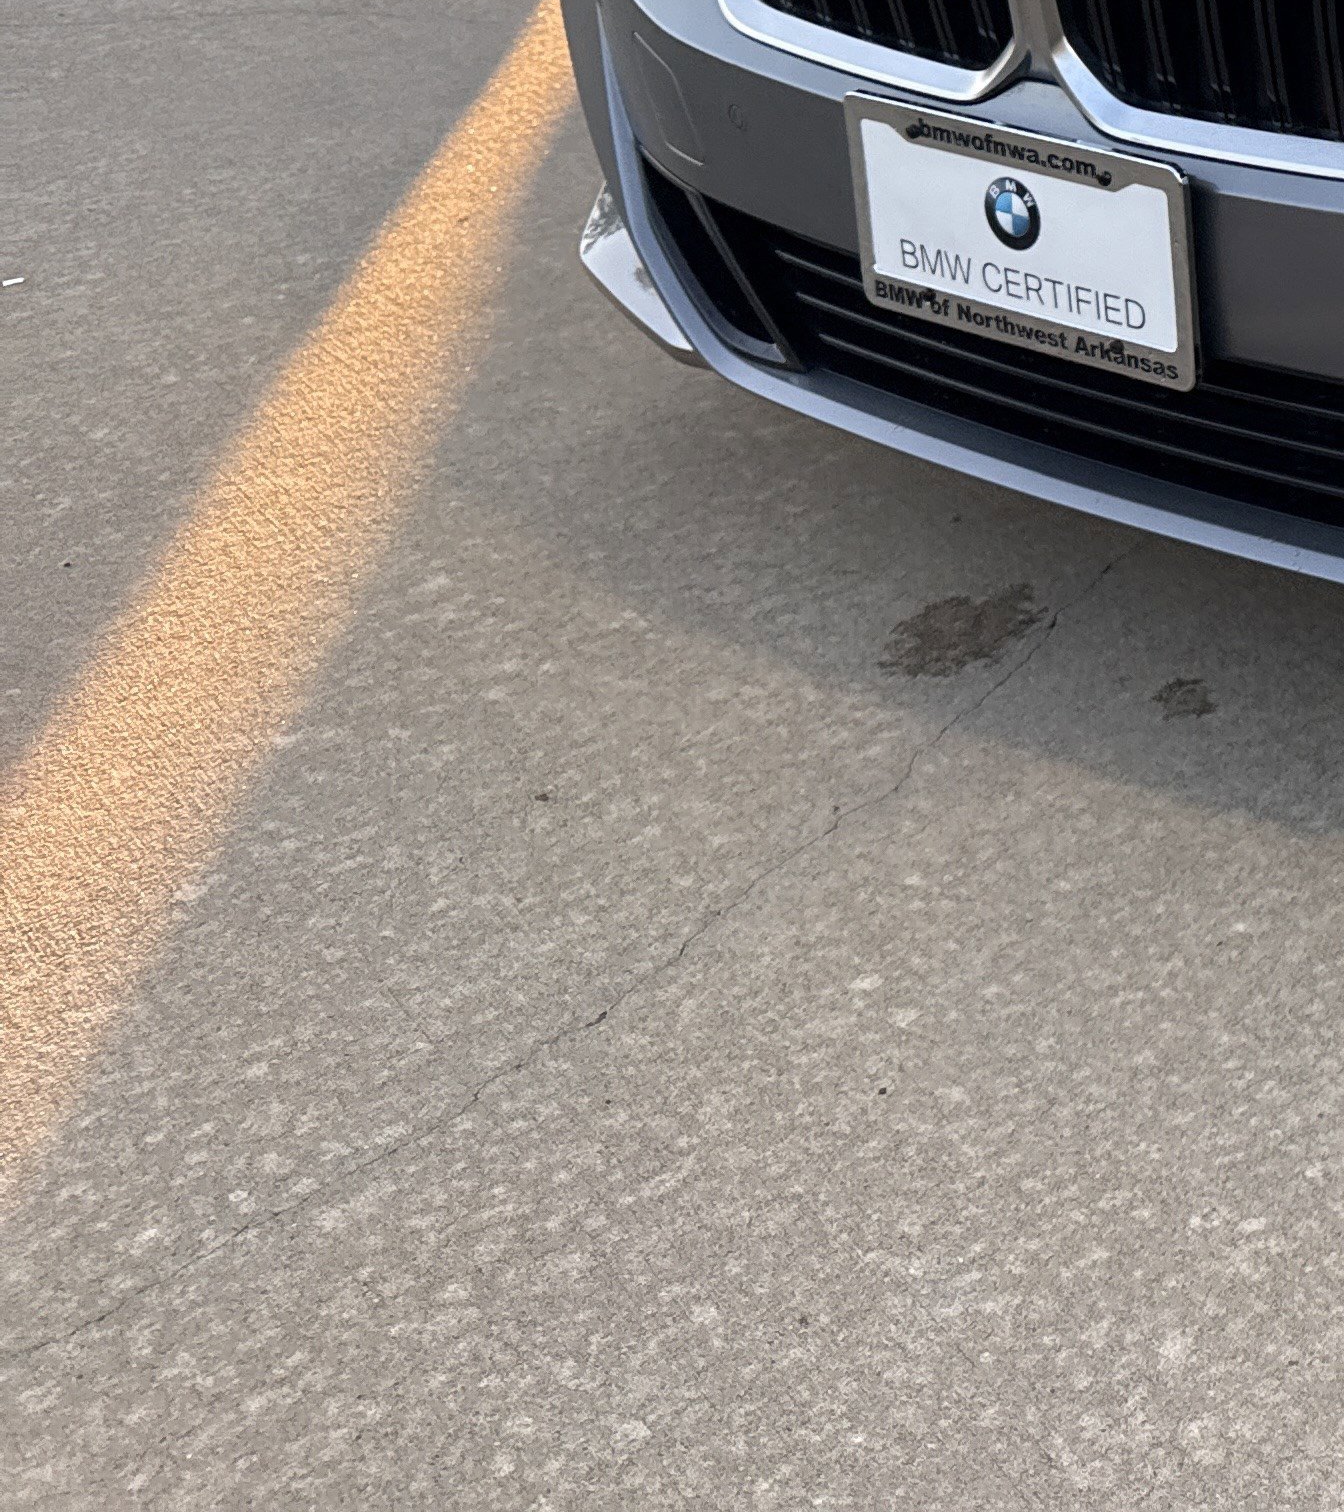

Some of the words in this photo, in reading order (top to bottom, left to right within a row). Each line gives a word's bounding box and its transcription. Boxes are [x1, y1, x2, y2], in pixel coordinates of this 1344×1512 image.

[918, 118, 1097, 176] bmwofnwa.com
[989, 179, 1036, 208] BMW
[899, 238, 972, 285] BMW
[981, 261, 1146, 330] CERTIFIED
[875, 279, 926, 310] BMW
[930, 297, 950, 317] of
[956, 302, 1069, 350] Northwest
[1074, 336, 1179, 380] Arkansas
